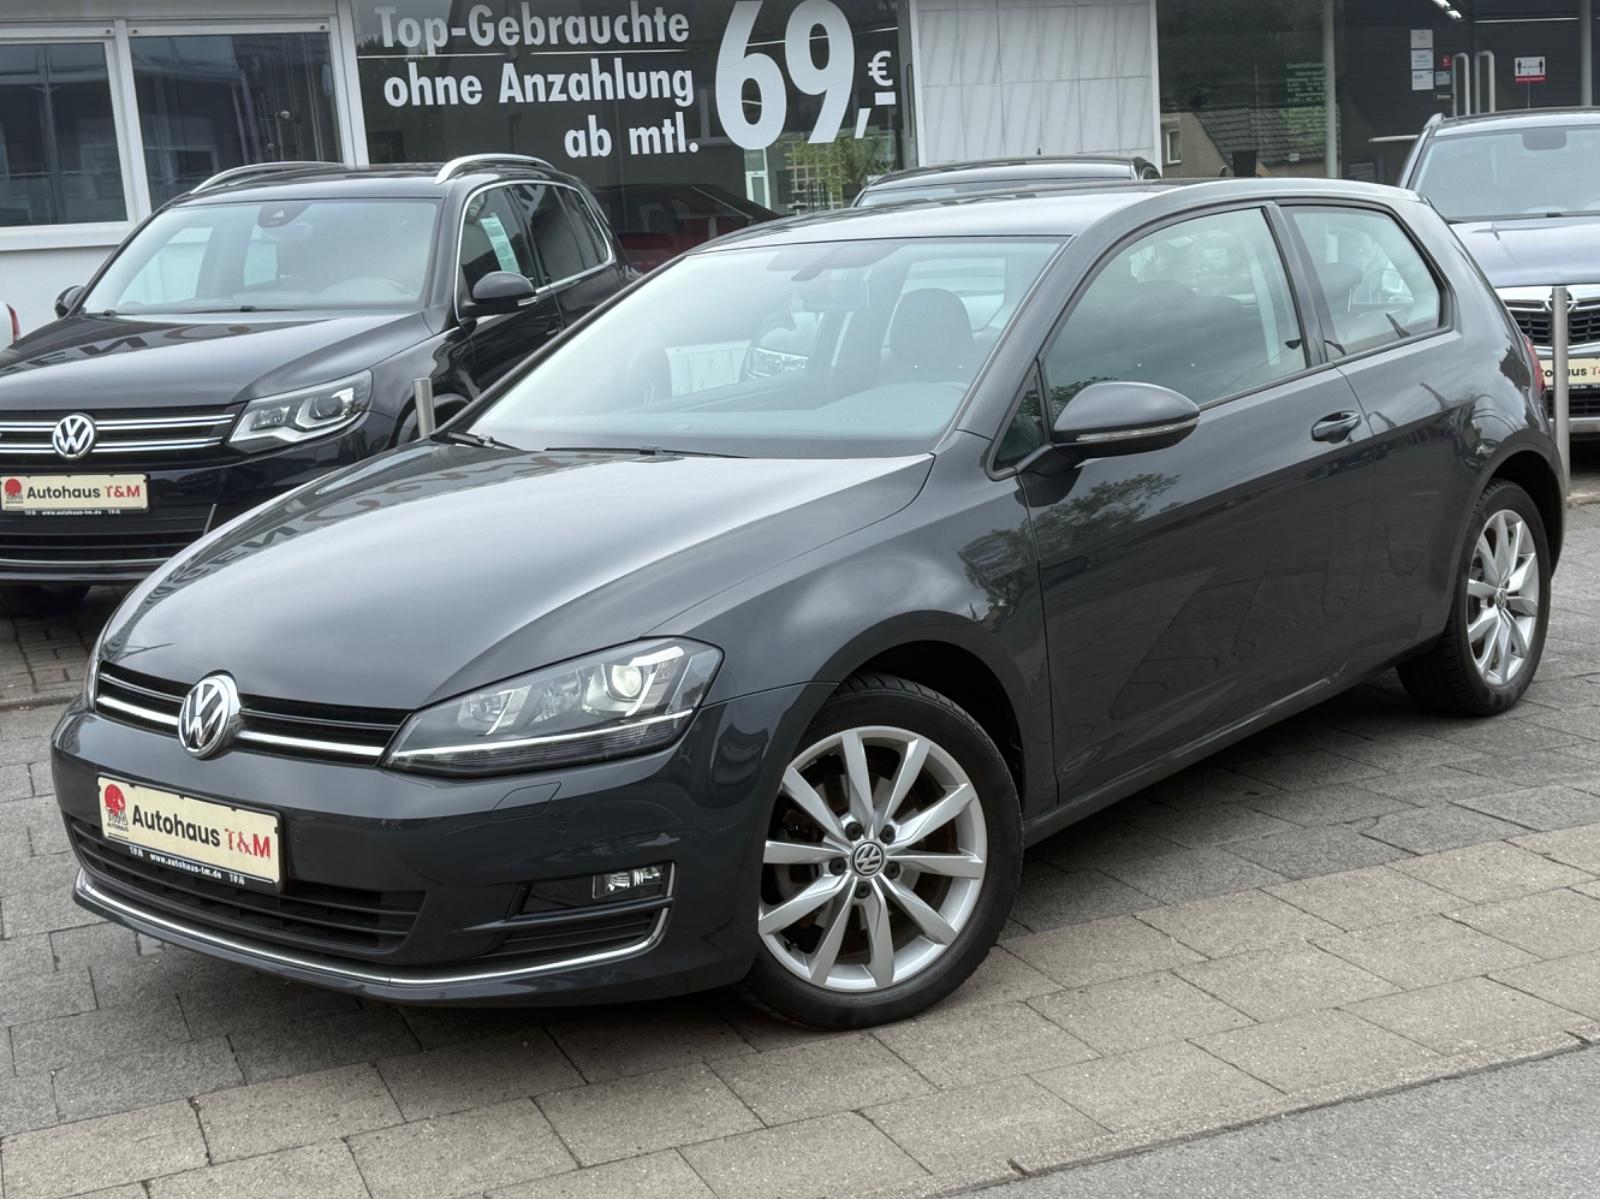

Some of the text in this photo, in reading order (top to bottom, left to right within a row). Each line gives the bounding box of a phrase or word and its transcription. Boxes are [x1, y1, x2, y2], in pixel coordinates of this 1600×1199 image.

[374, 1, 689, 55] Top-Gebrauchte
[383, 58, 694, 107] ohne Anzahlung
[564, 111, 699, 158] ab mtl.
[54, 414, 94, 458] VW
[27, 486, 101, 499] Autohaus
[105, 485, 140, 498] T&M
[181, 678, 229, 755] VW
[132, 805, 221, 847] Autohaus
[224, 828, 272, 859] T&M
[150, 854, 222, 880] www.autohaus-tm.de
